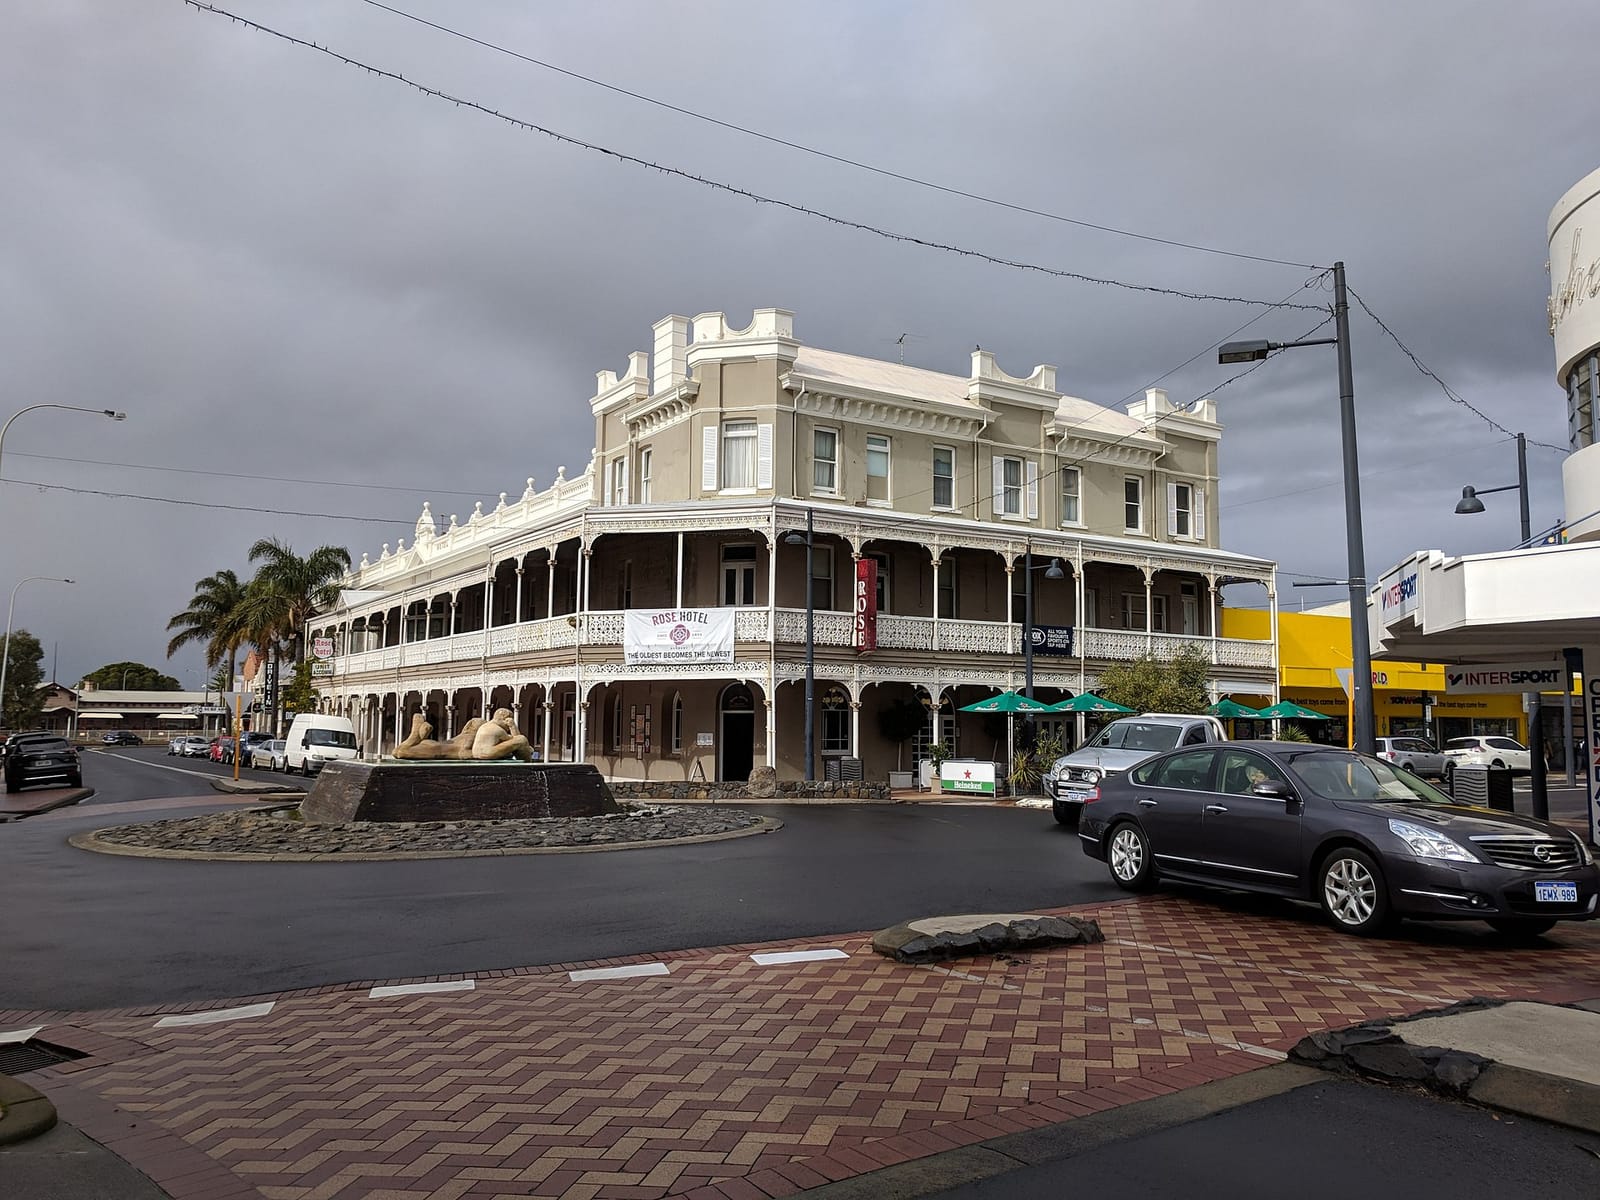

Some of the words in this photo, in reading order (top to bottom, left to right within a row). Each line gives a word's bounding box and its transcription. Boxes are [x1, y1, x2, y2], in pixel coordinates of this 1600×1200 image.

[1387, 573, 1416, 609] INTERSPORT
[651, 612, 677, 626] ROSE
[679, 611, 708, 624] HOTEL
[858, 581, 867, 646] ROSE
[707, 650, 731, 658] NEWEST
[1465, 670, 1560, 685] INTERSPORT
[954, 780, 982, 790] Heineken
[1539, 889, 1558, 900] 1EMX
[1561, 889, 1575, 900] 989
